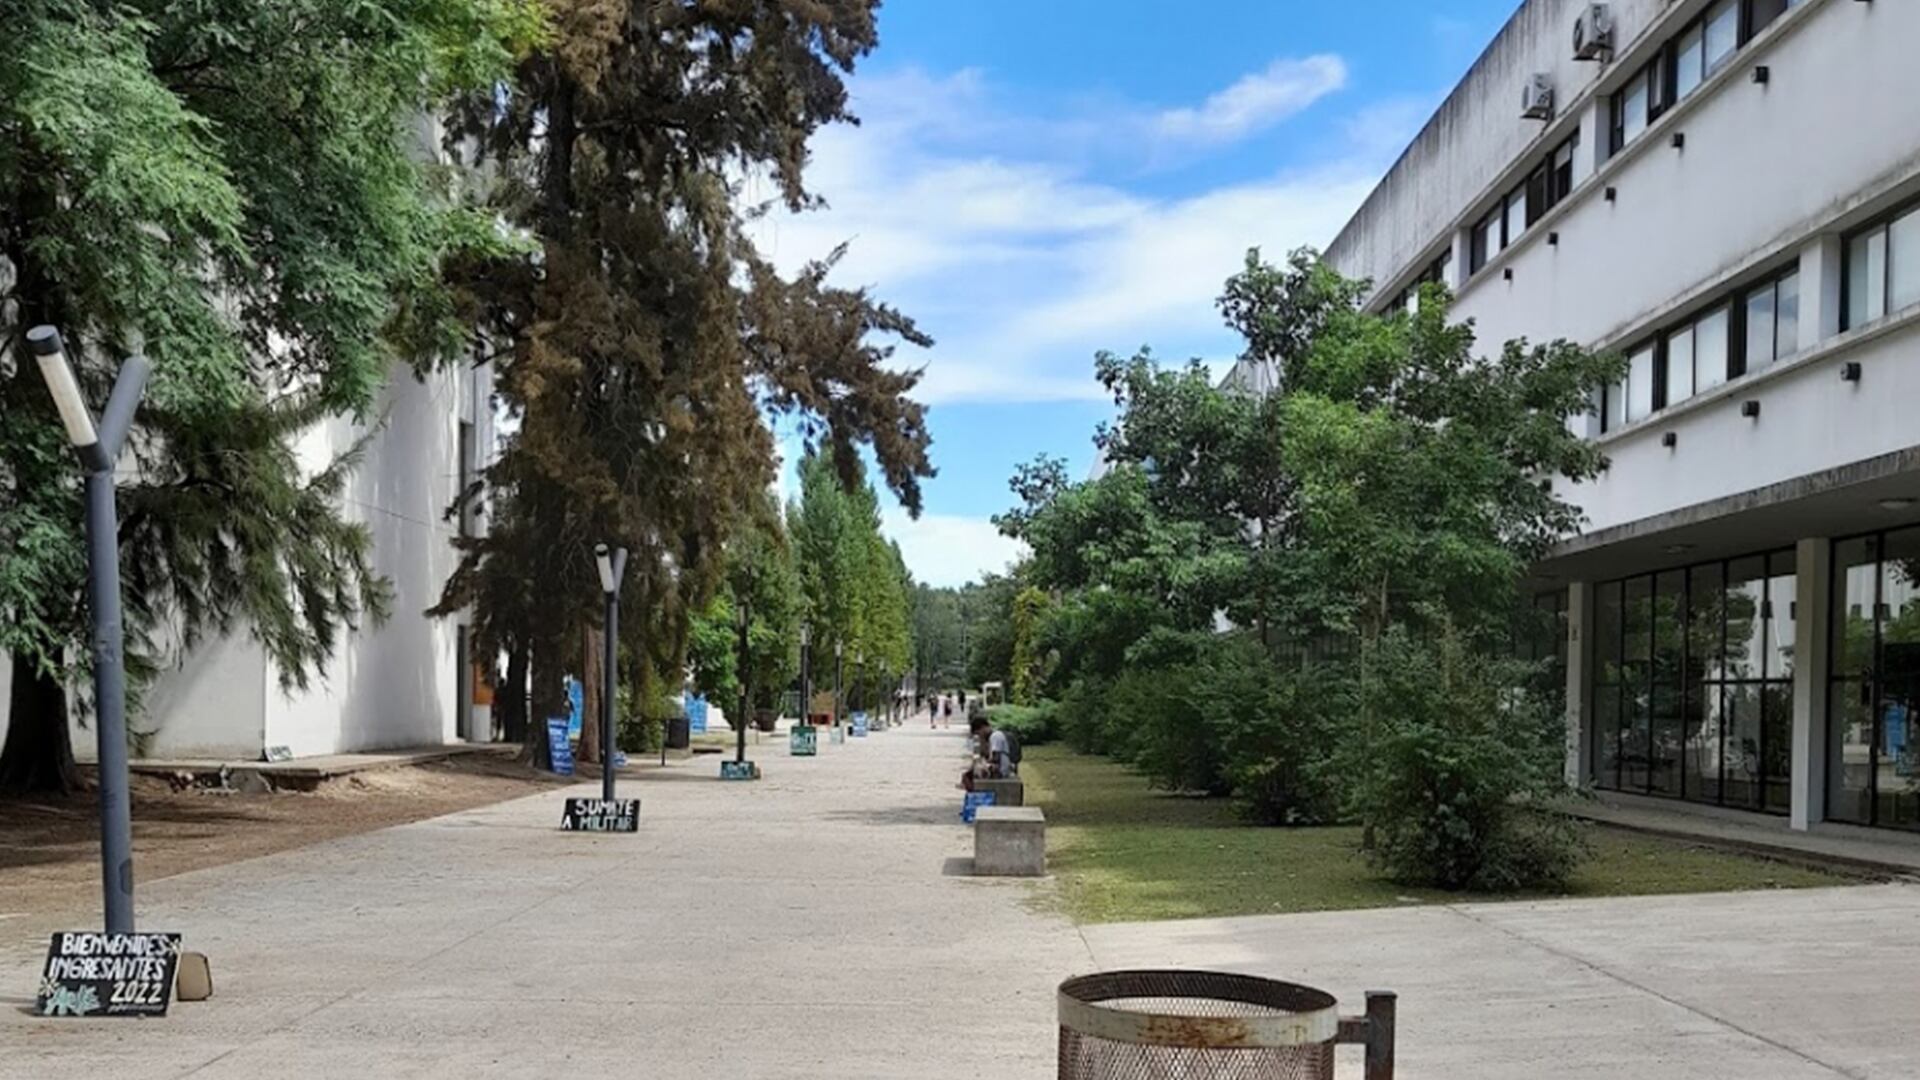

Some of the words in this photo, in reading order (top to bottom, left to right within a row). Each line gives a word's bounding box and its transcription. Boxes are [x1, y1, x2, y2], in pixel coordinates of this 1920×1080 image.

[562, 814, 572, 829] A
[579, 816, 633, 831] MILITAR
[61, 933, 168, 955] BIENVENIDES
[49, 956, 167, 981] INGRESANTES
[110, 981, 163, 1003] 2022
